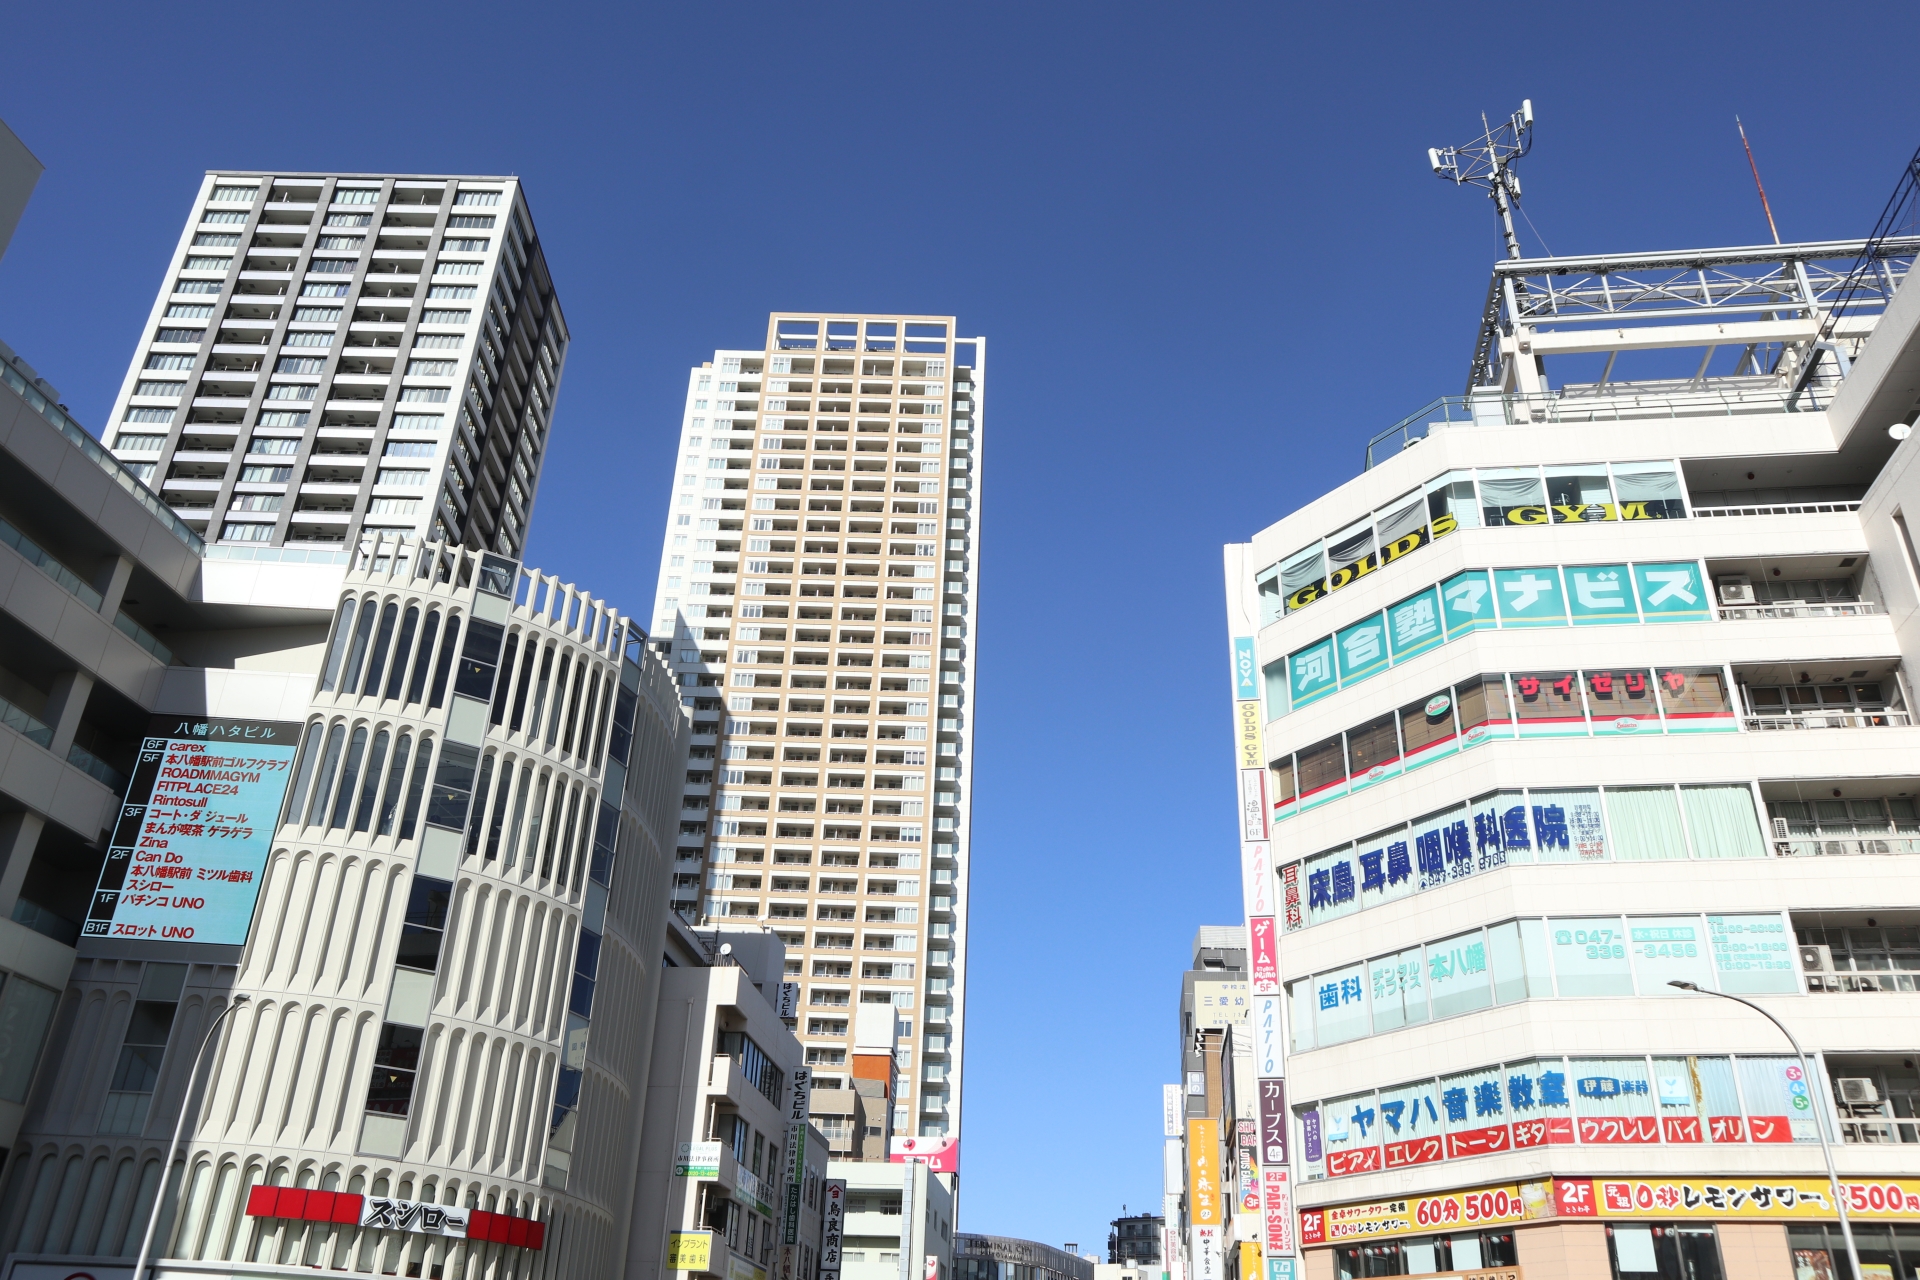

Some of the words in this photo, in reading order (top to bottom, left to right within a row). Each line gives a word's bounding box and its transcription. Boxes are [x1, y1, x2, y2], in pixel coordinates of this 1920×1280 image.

[1295, 570, 1697, 691] 河合塾マナビス
[1238, 650, 1252, 686] NOVA
[1518, 672, 1684, 695] サイゼリヤ
[174, 722, 275, 739] 八幡ハタビル
[1241, 704, 1256, 740] GOLD'S
[146, 740, 164, 749] 6F
[169, 742, 206, 753] carex
[142, 753, 160, 762] 5F
[165, 753, 290, 771] 本八幡駅前ゴルフクラブ
[1244, 744, 1258, 766] GYM
[161, 767, 260, 783] ROADMMAGYM
[156, 781, 239, 795] FITPLACE24
[152, 795, 207, 808] Rintosull
[125, 807, 143, 817] 3F
[1249, 828, 1262, 836] 6F
[139, 836, 168, 848] Zina
[110, 850, 129, 859] 2F
[135, 850, 162, 863] Can
[165, 852, 183, 864] Do
[126, 878, 174, 892] スシロー
[1252, 845, 1264, 912] PATIO
[100, 893, 115, 903] 1F
[121, 893, 168, 907] パチンコ
[172, 897, 204, 909] UNO
[1283, 865, 1301, 928] 耳鼻科
[85, 923, 109, 933] B1F
[112, 923, 157, 937] スロット
[161, 925, 194, 939] UNO
[1672, 928, 1693, 939] 休診
[1255, 920, 1271, 964] ゲーム
[1429, 941, 1486, 982] 本八幡
[1254, 971, 1276, 980] PRIMO
[1373, 961, 1420, 986] デンタル
[1260, 983, 1272, 992] 5F
[1319, 976, 1362, 1011] 歯科
[1374, 975, 1421, 999] オフィス
[1263, 1000, 1274, 1074] PATIO
[1351, 1070, 1569, 1137] ヤマハ音楽教室
[1265, 1082, 1282, 1144] カーブス
[1516, 1123, 1570, 1144] ギター
[1582, 1119, 1656, 1141] ウクレレ
[1667, 1119, 1775, 1141] バイオリン
[786, 1125, 798, 1182] 市川法律事務所
[1269, 1148, 1281, 1159] 4F
[1388, 1130, 1505, 1165] エレクトーン
[903, 1155, 942, 1169] コム
[1329, 1149, 1377, 1175] ピアノ
[1269, 1172, 1283, 1181] 2F
[1562, 1182, 1589, 1203] 2F
[1246, 1197, 1259, 1207] 3F
[1331, 1202, 1406, 1220] 全卓サワータワー完備
[1417, 1199, 1460, 1225] 60分
[1466, 1190, 1524, 1220] 500円
[1565, 1205, 1591, 1214] ときわ亭
[364, 1199, 466, 1230] スシロー
[1303, 1214, 1322, 1232] 2F
[825, 1201, 841, 1264] 鳥良商店
[1284, 1217, 1292, 1251] パーソンズ
[1203, 1238, 1211, 1275] 中華食堂
[1275, 1261, 1289, 1272] 7F
